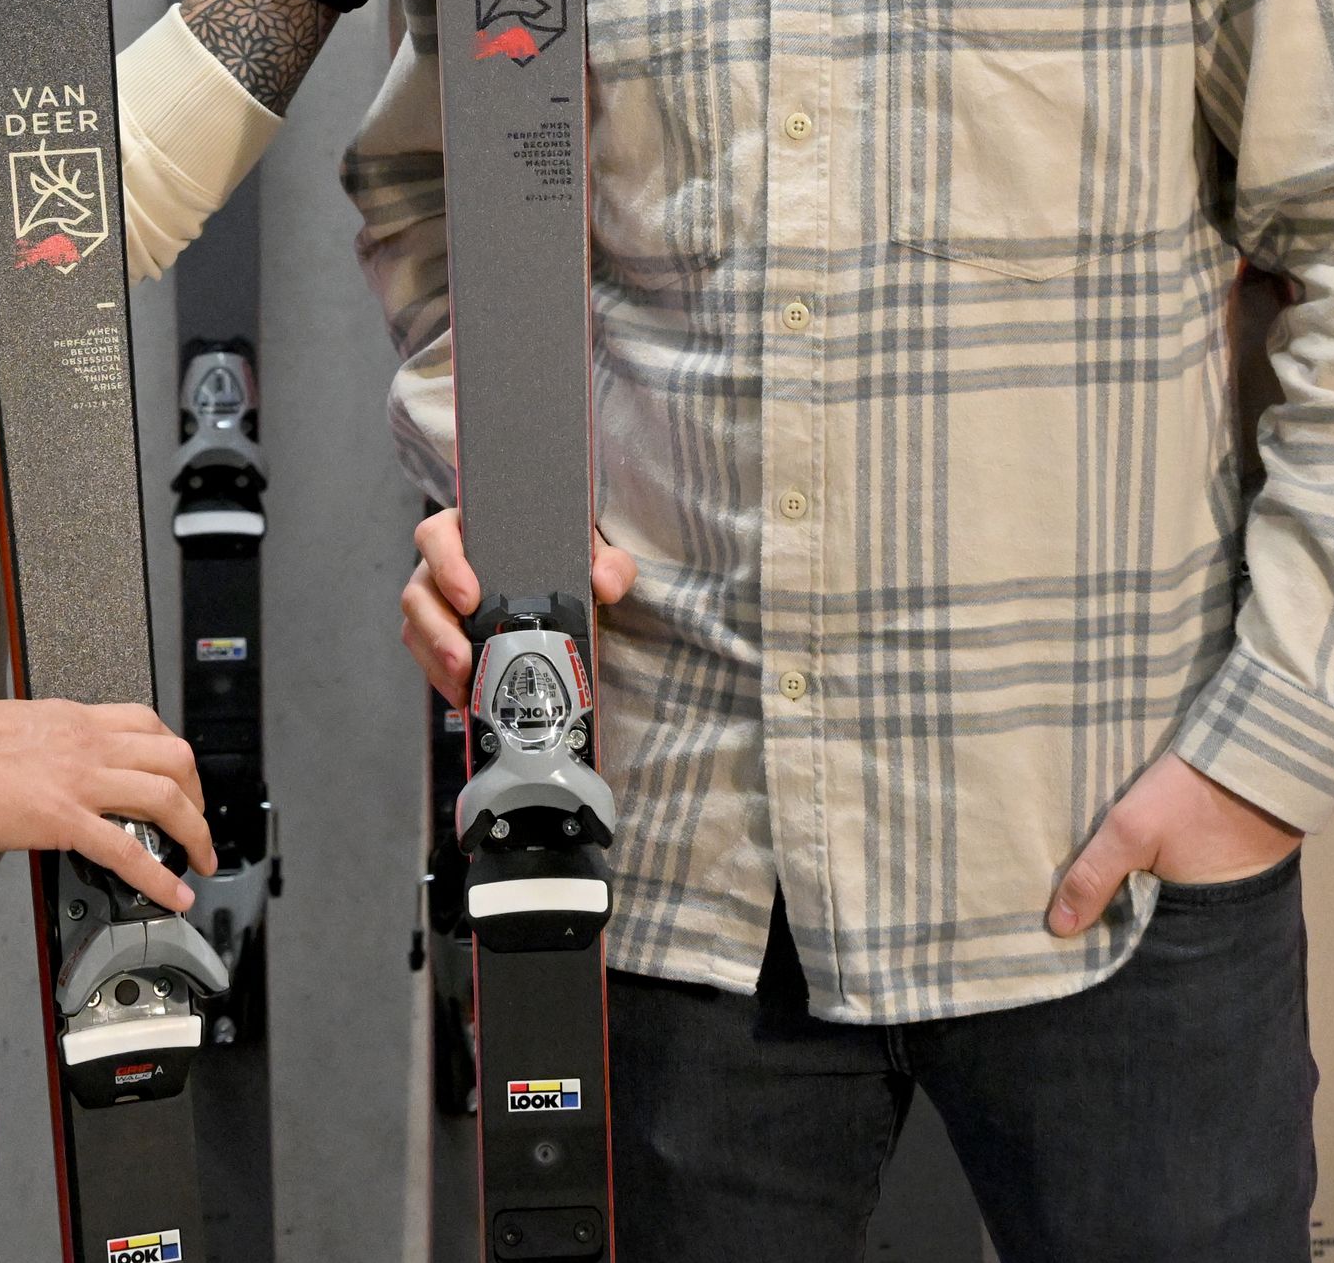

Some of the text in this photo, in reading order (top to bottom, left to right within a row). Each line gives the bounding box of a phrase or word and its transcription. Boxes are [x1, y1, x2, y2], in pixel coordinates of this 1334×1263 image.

[12, 84, 87, 110] VAN
[6, 109, 100, 137] DEER
[540, 122, 570, 130] WHEN
[507, 131, 571, 140] PERFECTION
[523, 140, 571, 149] BECOMES
[525, 159, 572, 167] MAGICAL
[534, 168, 572, 176] THINGS
[541, 177, 572, 185] ARISE
[87, 327, 118, 336] WHEN
[53, 336, 119, 348] PERFECTION
[70, 345, 120, 356] BECOMES
[61, 355, 121, 366] OBSESSION
[74, 364, 122, 374] MAGICAL
[84, 373, 122, 383] THINGS
[93, 382, 124, 391] ARISE
[519, 706, 563, 718] LOOK
[565, 927, 574, 936] A
[154, 1065, 164, 1075] A
[510, 1094, 560, 1110] LOOK
